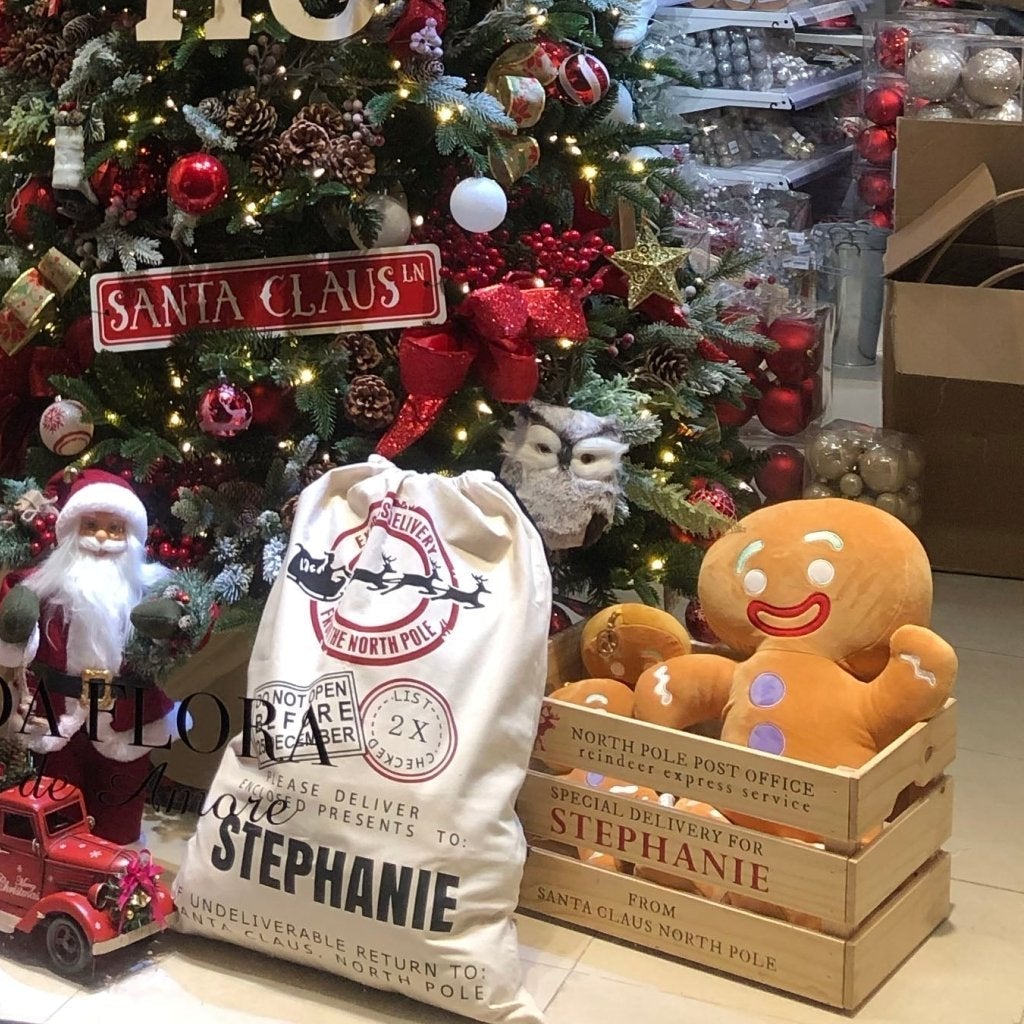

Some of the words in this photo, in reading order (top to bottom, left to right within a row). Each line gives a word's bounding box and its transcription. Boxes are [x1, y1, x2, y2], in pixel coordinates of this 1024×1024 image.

[107, 279, 245, 333] SANTA
[258, 265, 401, 318] CLAUS
[402, 262, 425, 284] LN
[348, 636, 399, 656] NORTH
[400, 619, 437, 651] POLE
[85, 680, 338, 768] FLORA
[272, 689, 307, 709] NOT
[308, 680, 346, 704] OPEN
[393, 689, 433, 710] LIST
[274, 726, 356, 751] ECEMBER
[367, 737, 435, 770] CHECKED
[571, 726, 635, 754] NORTH
[641, 742, 688, 767] POLE
[694, 754, 739, 778] POST
[745, 768, 815, 797] OFFICE
[19, 751, 80, 802] de
[97, 761, 305, 825] Amore
[239, 778, 306, 812] ENCLOSED
[318, 803, 414, 838] PRESENTS
[437, 829, 467, 848] TO:
[266, 770, 320, 798] PLEASE
[335, 789, 420, 820] DELIVER
[579, 746, 655, 774] reindeer
[663, 766, 733, 793] express
[742, 787, 811, 813] service
[550, 786, 624, 818] SPECIAL
[629, 806, 723, 843] DELIVERY
[727, 834, 764, 856] FOR
[550, 807, 770, 893] STEPHANIE
[211, 814, 461, 933] STEPHANIE
[628, 892, 677, 918] FROM
[179, 907, 230, 931] ANTA
[336, 953, 411, 986] NORTH
[425, 981, 485, 1001] POLE
[190, 893, 346, 952] UNDELIVERABLE
[356, 945, 437, 978] RETURN
[450, 964, 486, 980] TO:
[537, 886, 592, 915] SANTA
[596, 905, 653, 933] CLAUS
[658, 922, 723, 955] NORTH
[729, 944, 777, 972] POLE
